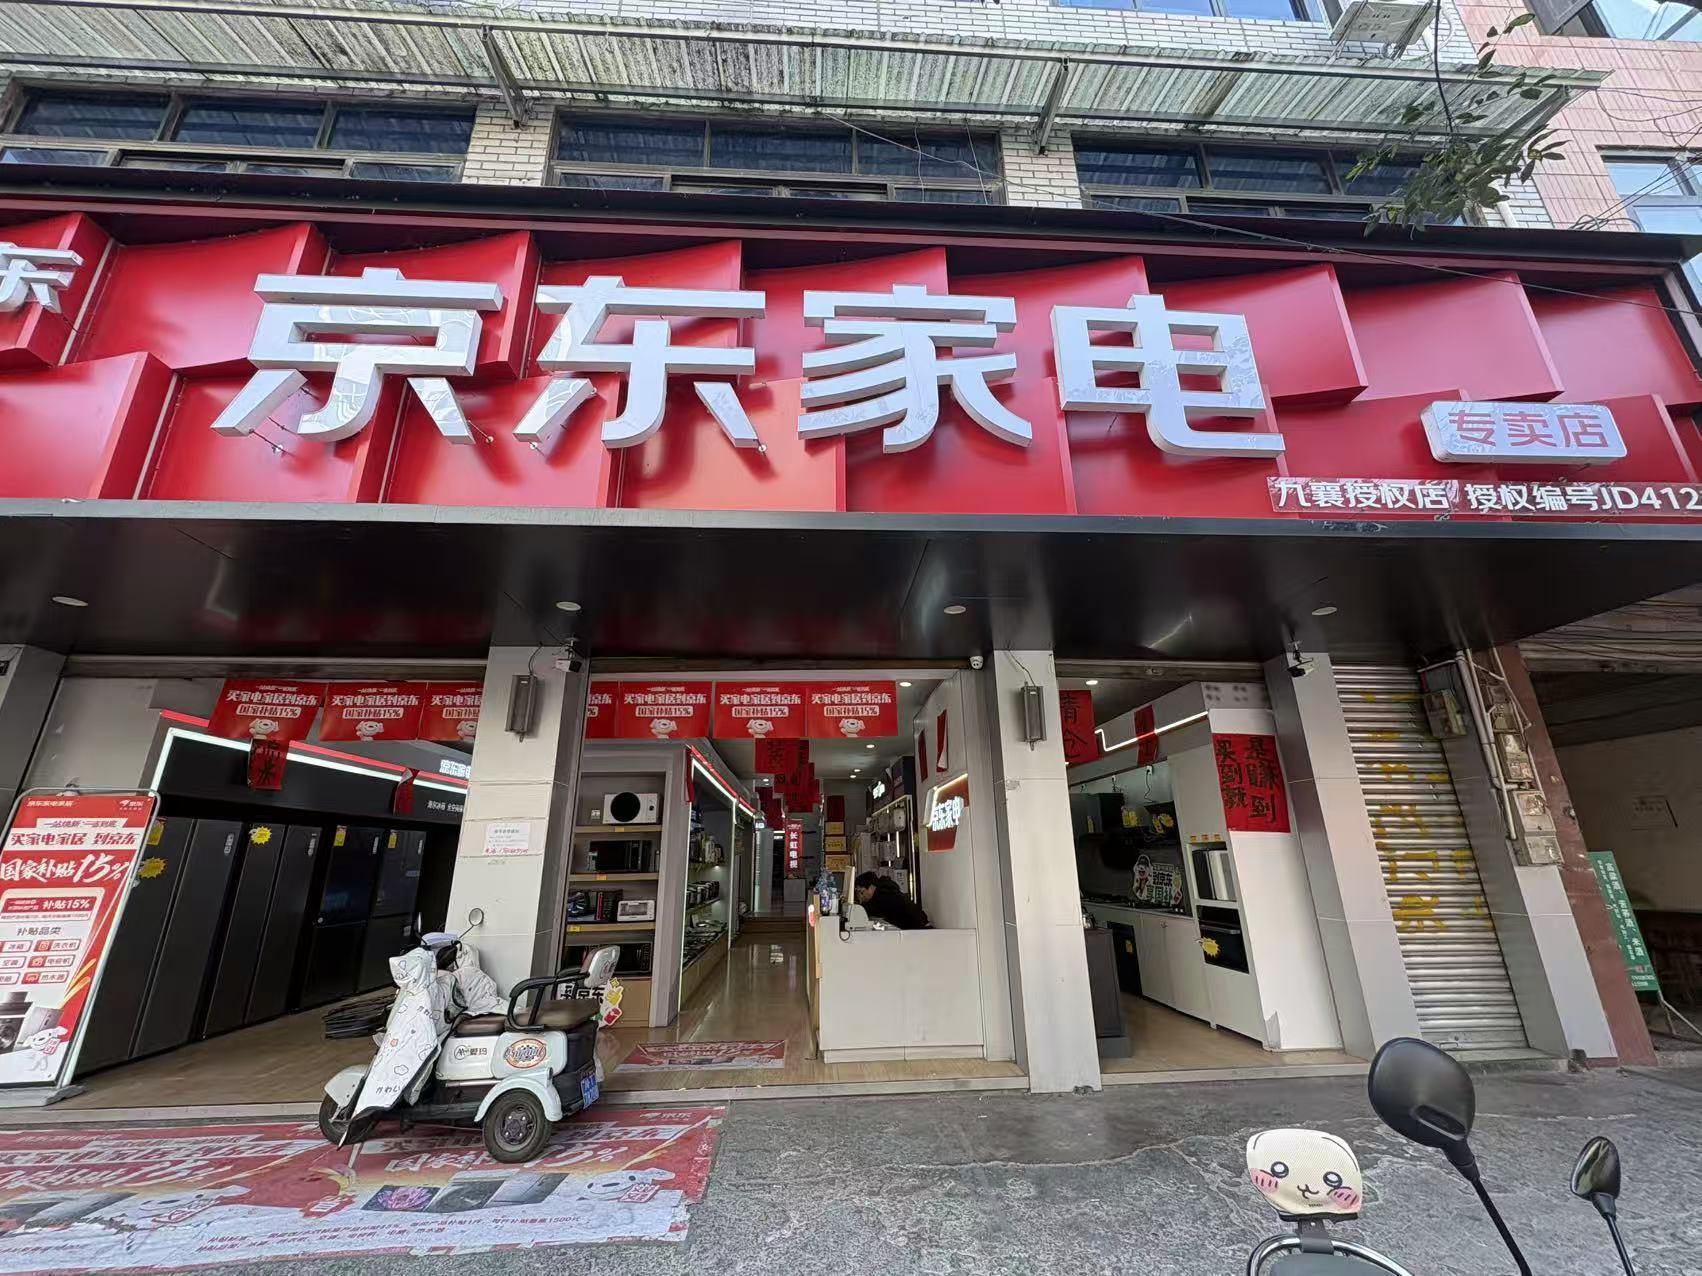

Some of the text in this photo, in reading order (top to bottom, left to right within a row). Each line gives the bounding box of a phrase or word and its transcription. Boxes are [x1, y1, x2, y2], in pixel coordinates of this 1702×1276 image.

[210, 266, 1286, 459] 京东家电
[1448, 408, 1610, 450] 专卖店
[1276, 480, 1451, 511] 九襄授权店
[226, 689, 319, 706] 买家电家居到京东
[331, 694, 419, 706] 买家电家居到京东
[588, 693, 612, 704] 京东
[624, 693, 707, 704] 买家电家居到京东
[720, 693, 801, 704] 买家电家居到京东
[811, 693, 892, 704] 买家电家居到京东
[239, 704, 299, 717] 国家补贴15%
[344, 708, 401, 718] 国家补贴15%
[638, 707, 691, 716] 国家补贴15%
[734, 707, 786, 716] 国家补贴15%
[826, 706, 878, 715] 国家补贴15%
[11, 832, 139, 846] 买家电家居 到京东
[789, 831, 798, 869] 长虹电视
[0, 853, 129, 883] 国家补贴15%
[43, 899, 90, 910] 补贴15%
[17, 926, 62, 936] 补贴品类
